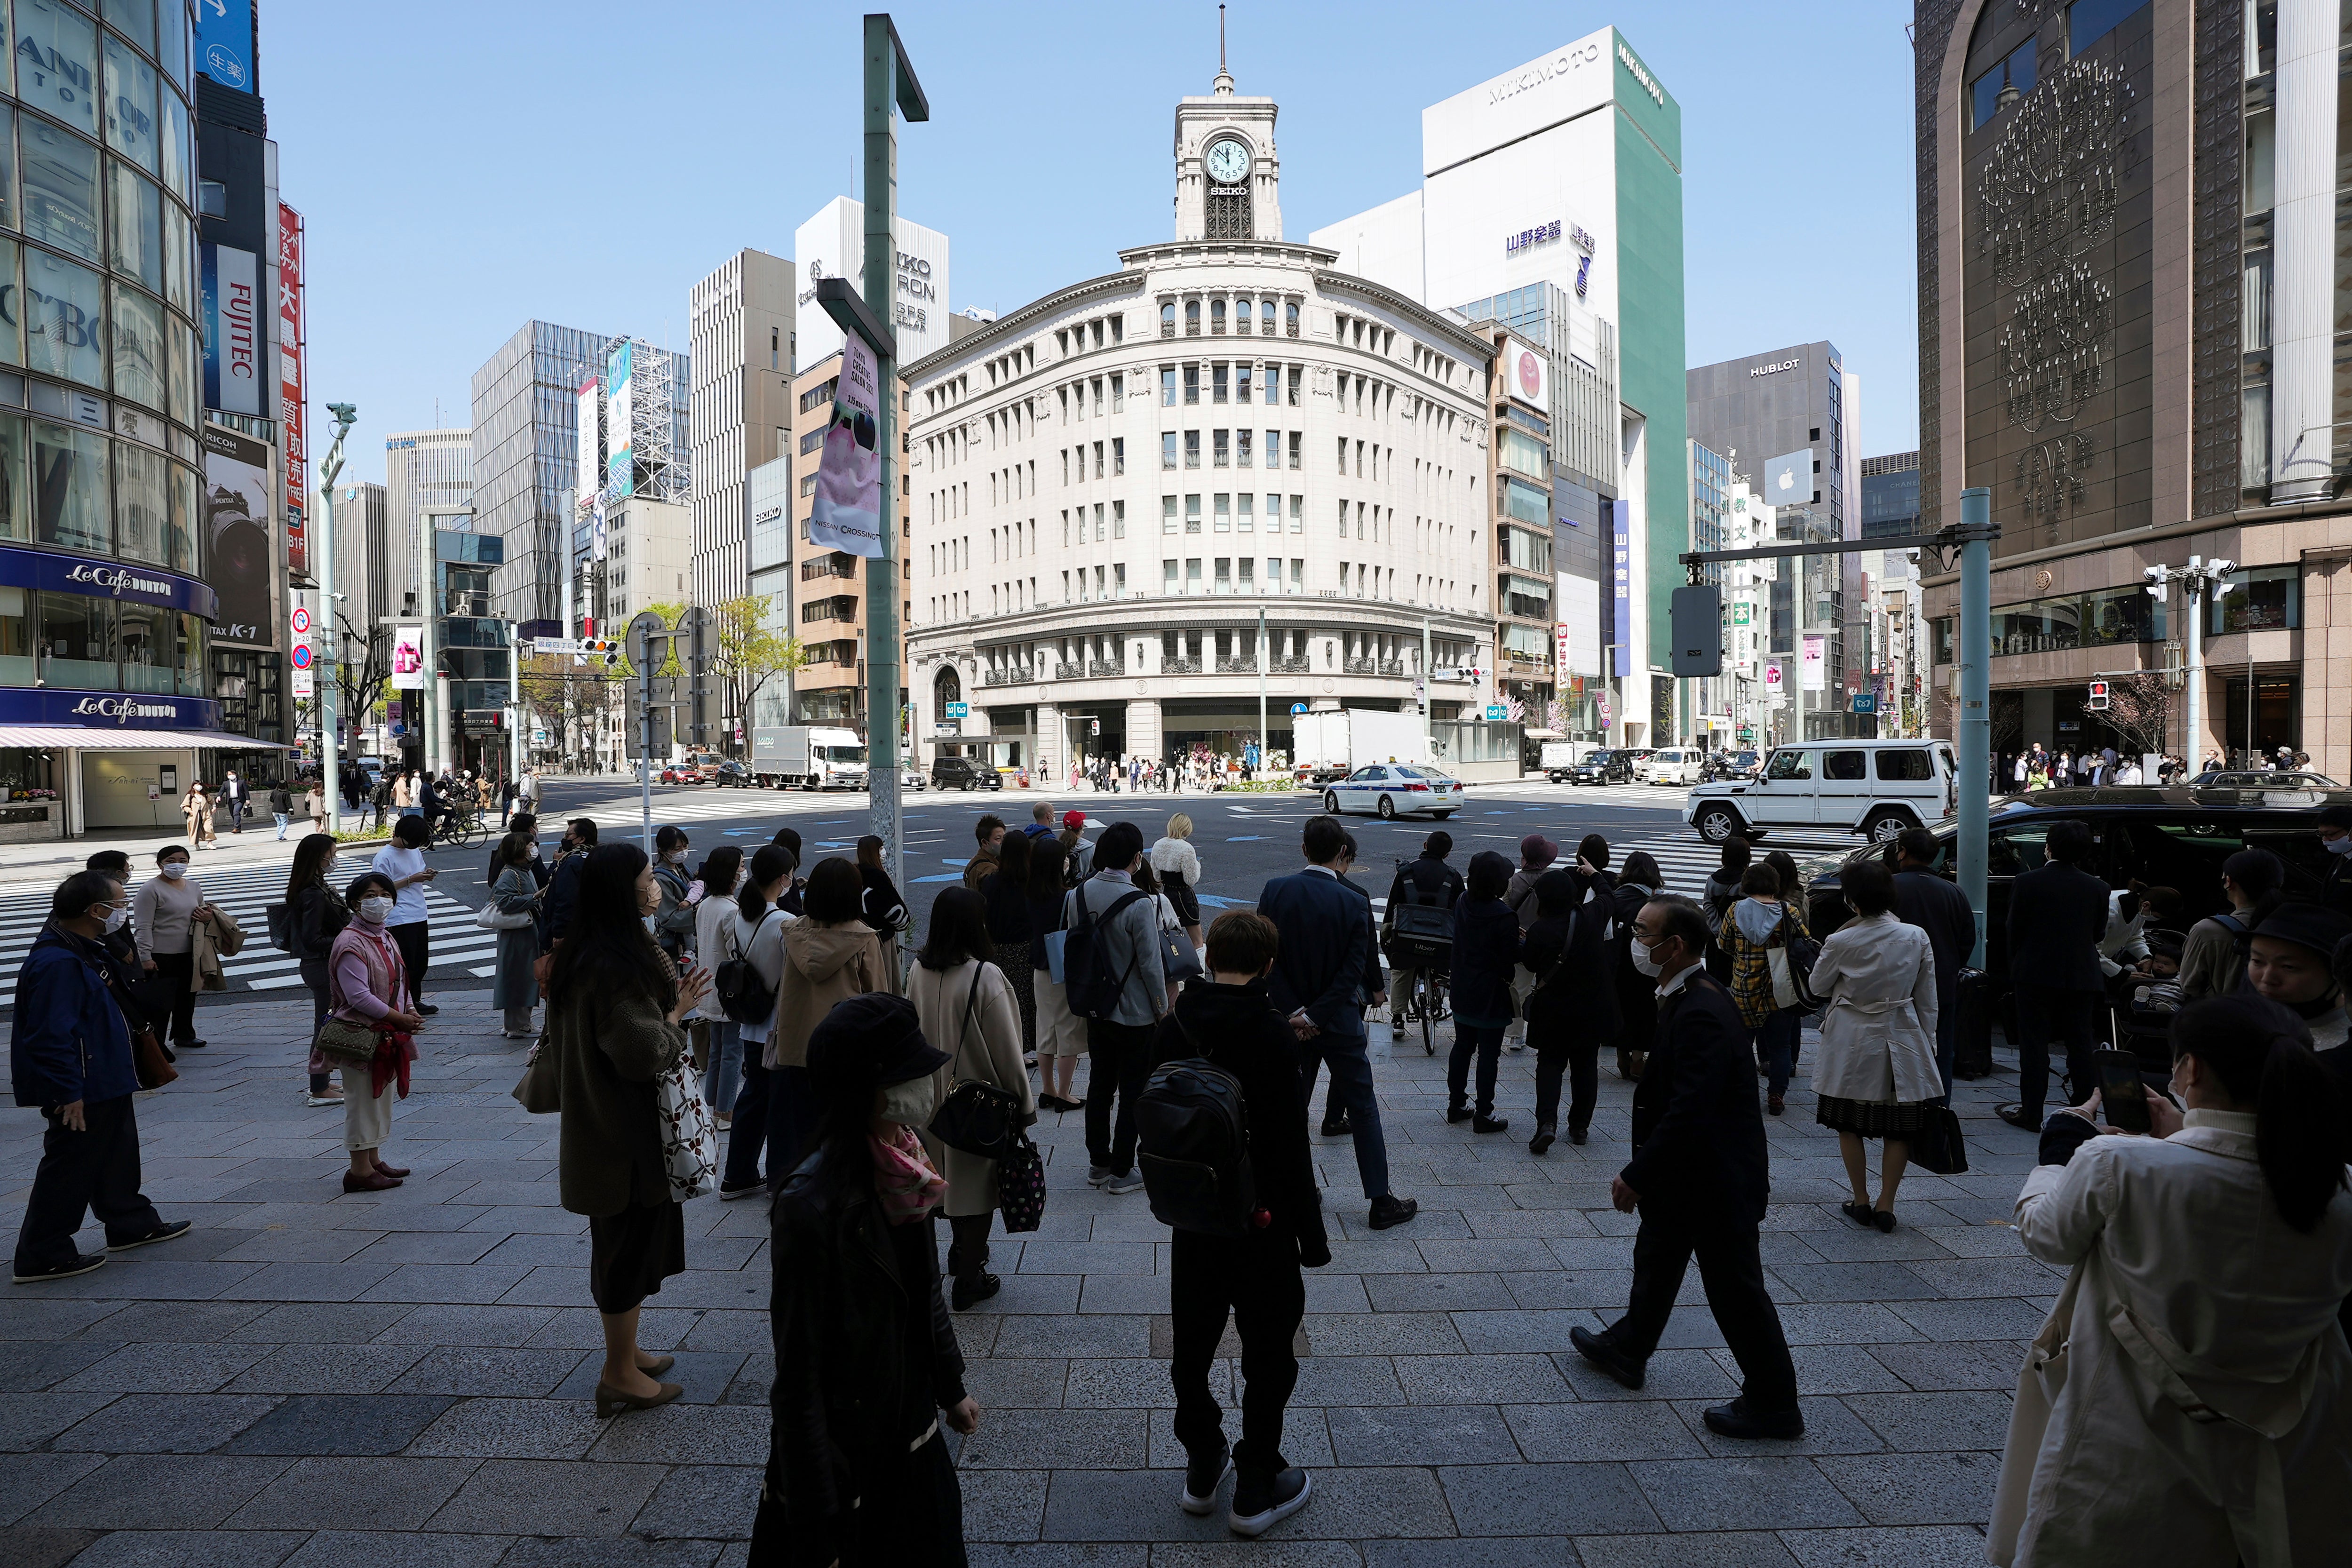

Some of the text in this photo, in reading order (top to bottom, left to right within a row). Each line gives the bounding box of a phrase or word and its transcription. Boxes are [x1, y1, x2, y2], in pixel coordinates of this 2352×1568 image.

[210, 52, 242, 81] 生薬
[1489, 43, 1599, 105] MIKIMOTO
[1618, 41, 1664, 108] MIKIMOTO
[1210, 187, 1247, 196] SEIKO
[279, 223, 298, 248] ランド
[1507, 220, 1561, 252] 山野楽器
[1570, 220, 1596, 253] 山野楽器
[282, 242, 290, 255] &
[896, 251, 930, 276] IKO
[221, 281, 252, 379] FUJITEC
[280, 282, 299, 388] 大黒屋
[854, 347, 866, 365] TOKYO
[1750, 358, 1799, 377] HUBLOT
[851, 371, 866, 389] SALON
[852, 358, 871, 382] CREATIVE
[282, 396, 299, 430] 質
[206, 432, 237, 449] RICOH
[286, 429, 302, 458] 取
[287, 485, 302, 502] YFREE
[755, 505, 781, 524] SEIKO
[288, 534, 304, 550] B1F
[815, 520, 876, 540] NISSAN CROSSING
[1615, 533, 1628, 598] 山野楽器
[66, 565, 171, 597] Le Café DOUTOR
[1735, 605, 1748, 621] 本
[210, 623, 257, 639] TAX K-1
[538, 640, 574, 649] 銀座四丁目
[72, 697, 176, 724] Le Café DOUTOR
[1415, 943, 1436, 952] Uber
